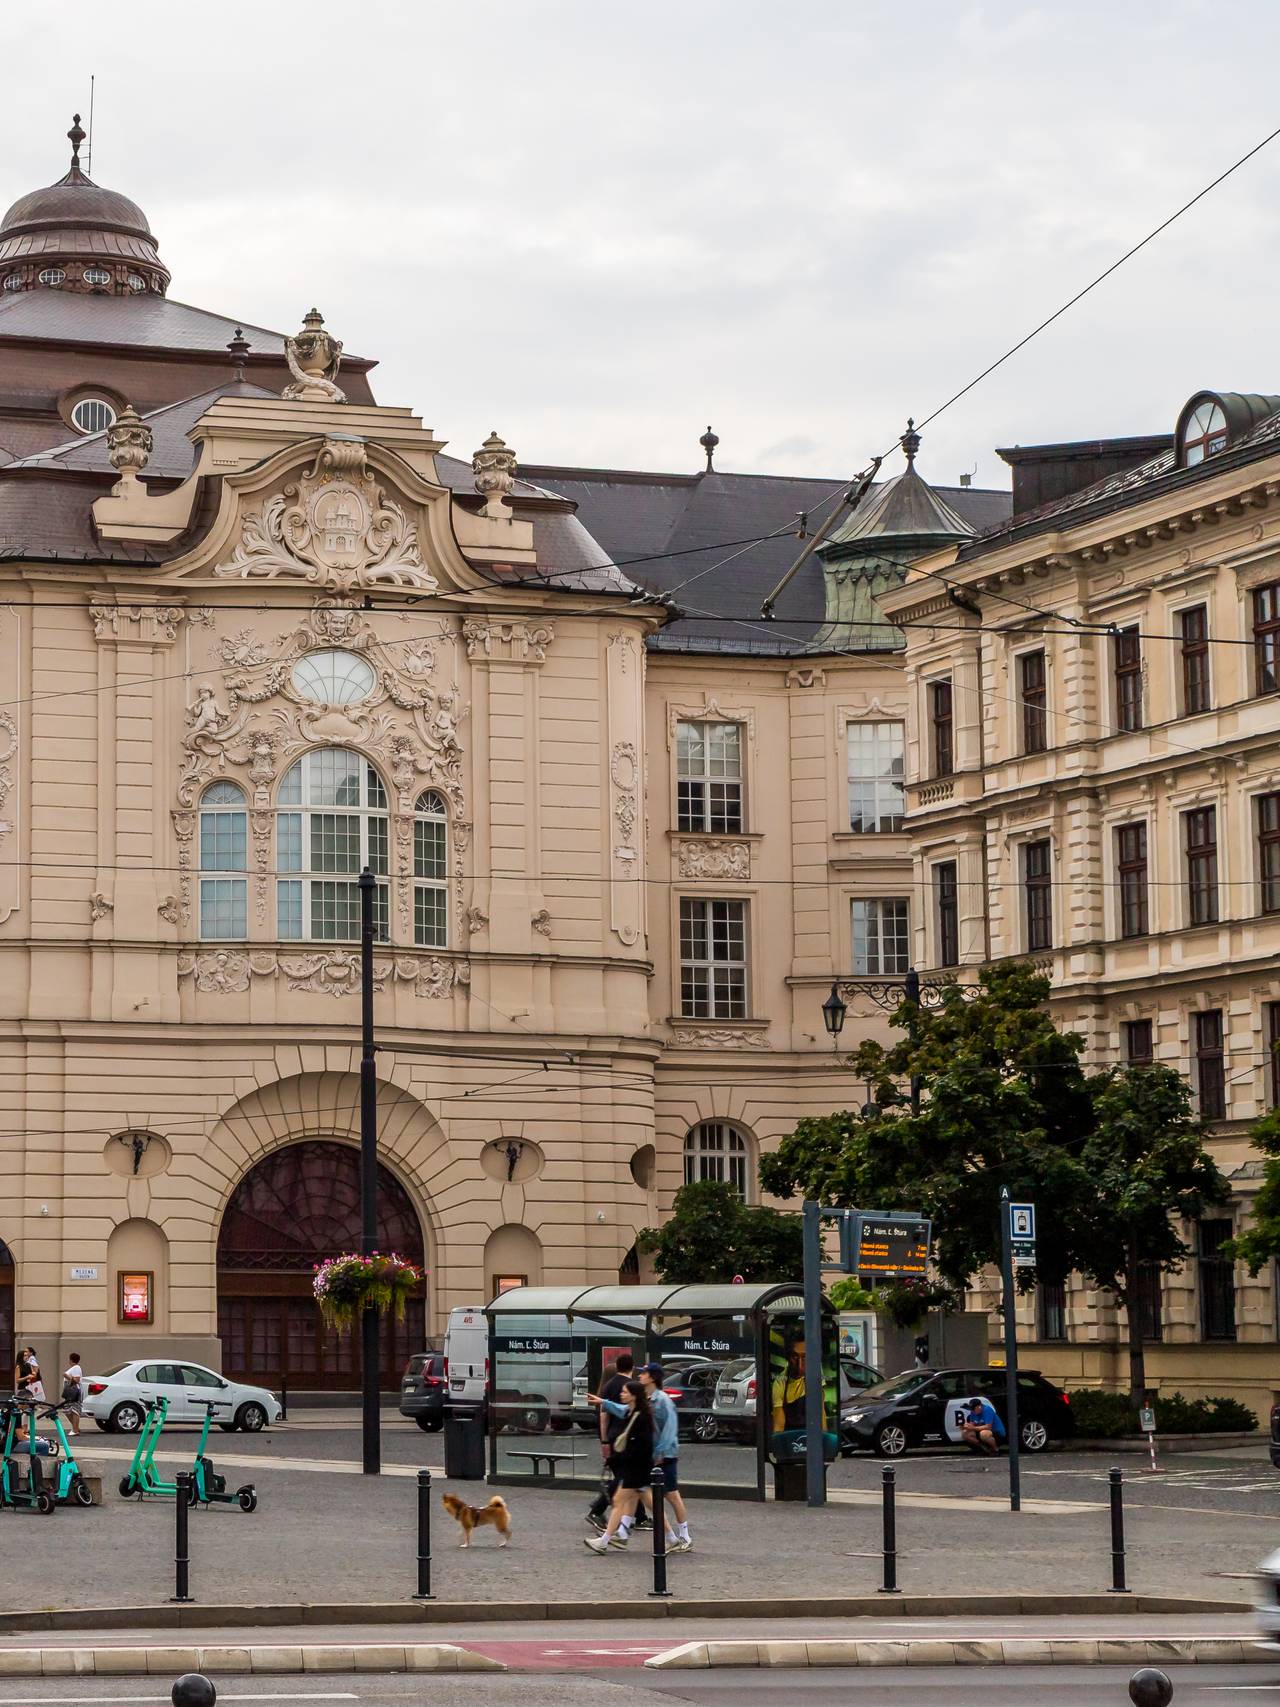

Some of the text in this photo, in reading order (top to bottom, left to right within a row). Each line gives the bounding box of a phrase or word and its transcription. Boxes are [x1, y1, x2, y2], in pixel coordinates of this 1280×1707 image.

[1002, 1187, 1009, 1198] A
[509, 1340, 525, 1349] Nám.
[533, 1339, 550, 1350] Štúra
[684, 1340, 702, 1350] Nám.
[711, 1340, 730, 1351] Štúra
